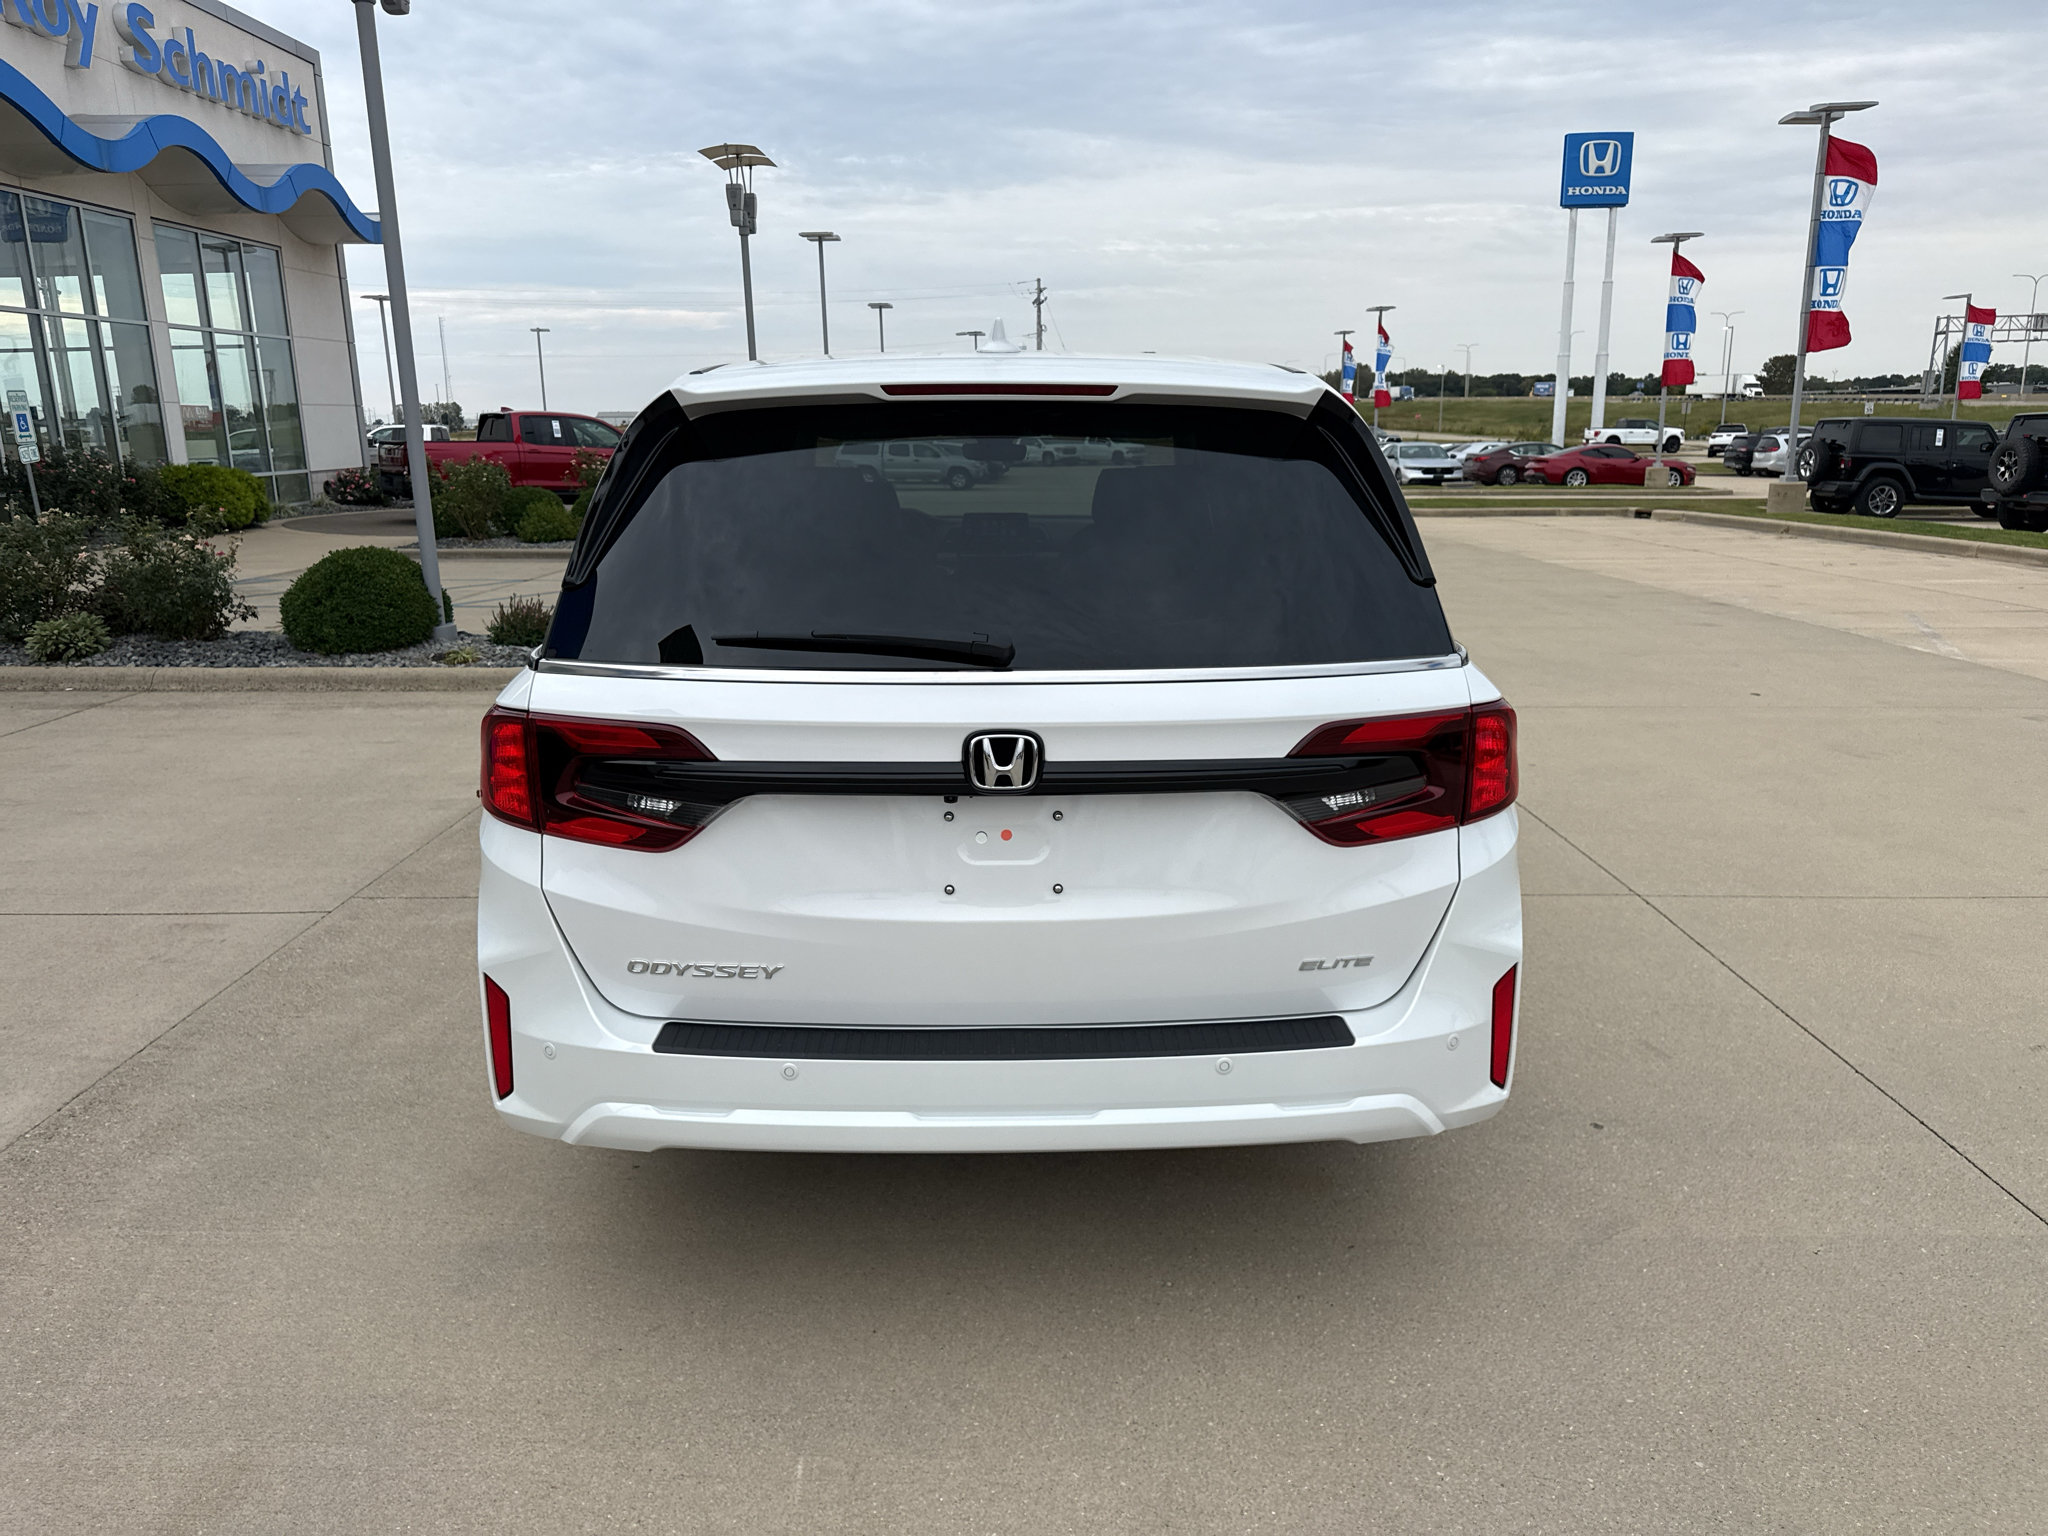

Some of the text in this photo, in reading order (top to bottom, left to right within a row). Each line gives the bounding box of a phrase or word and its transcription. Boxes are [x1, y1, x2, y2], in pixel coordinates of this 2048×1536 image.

[0, 0, 312, 134] oy Schmidt
[1567, 185, 1627, 196] HONDA
[1820, 209, 1862, 220] HONDA
[627, 957, 785, 980] ODYSSEY
[1298, 953, 1375, 972] ELITE
